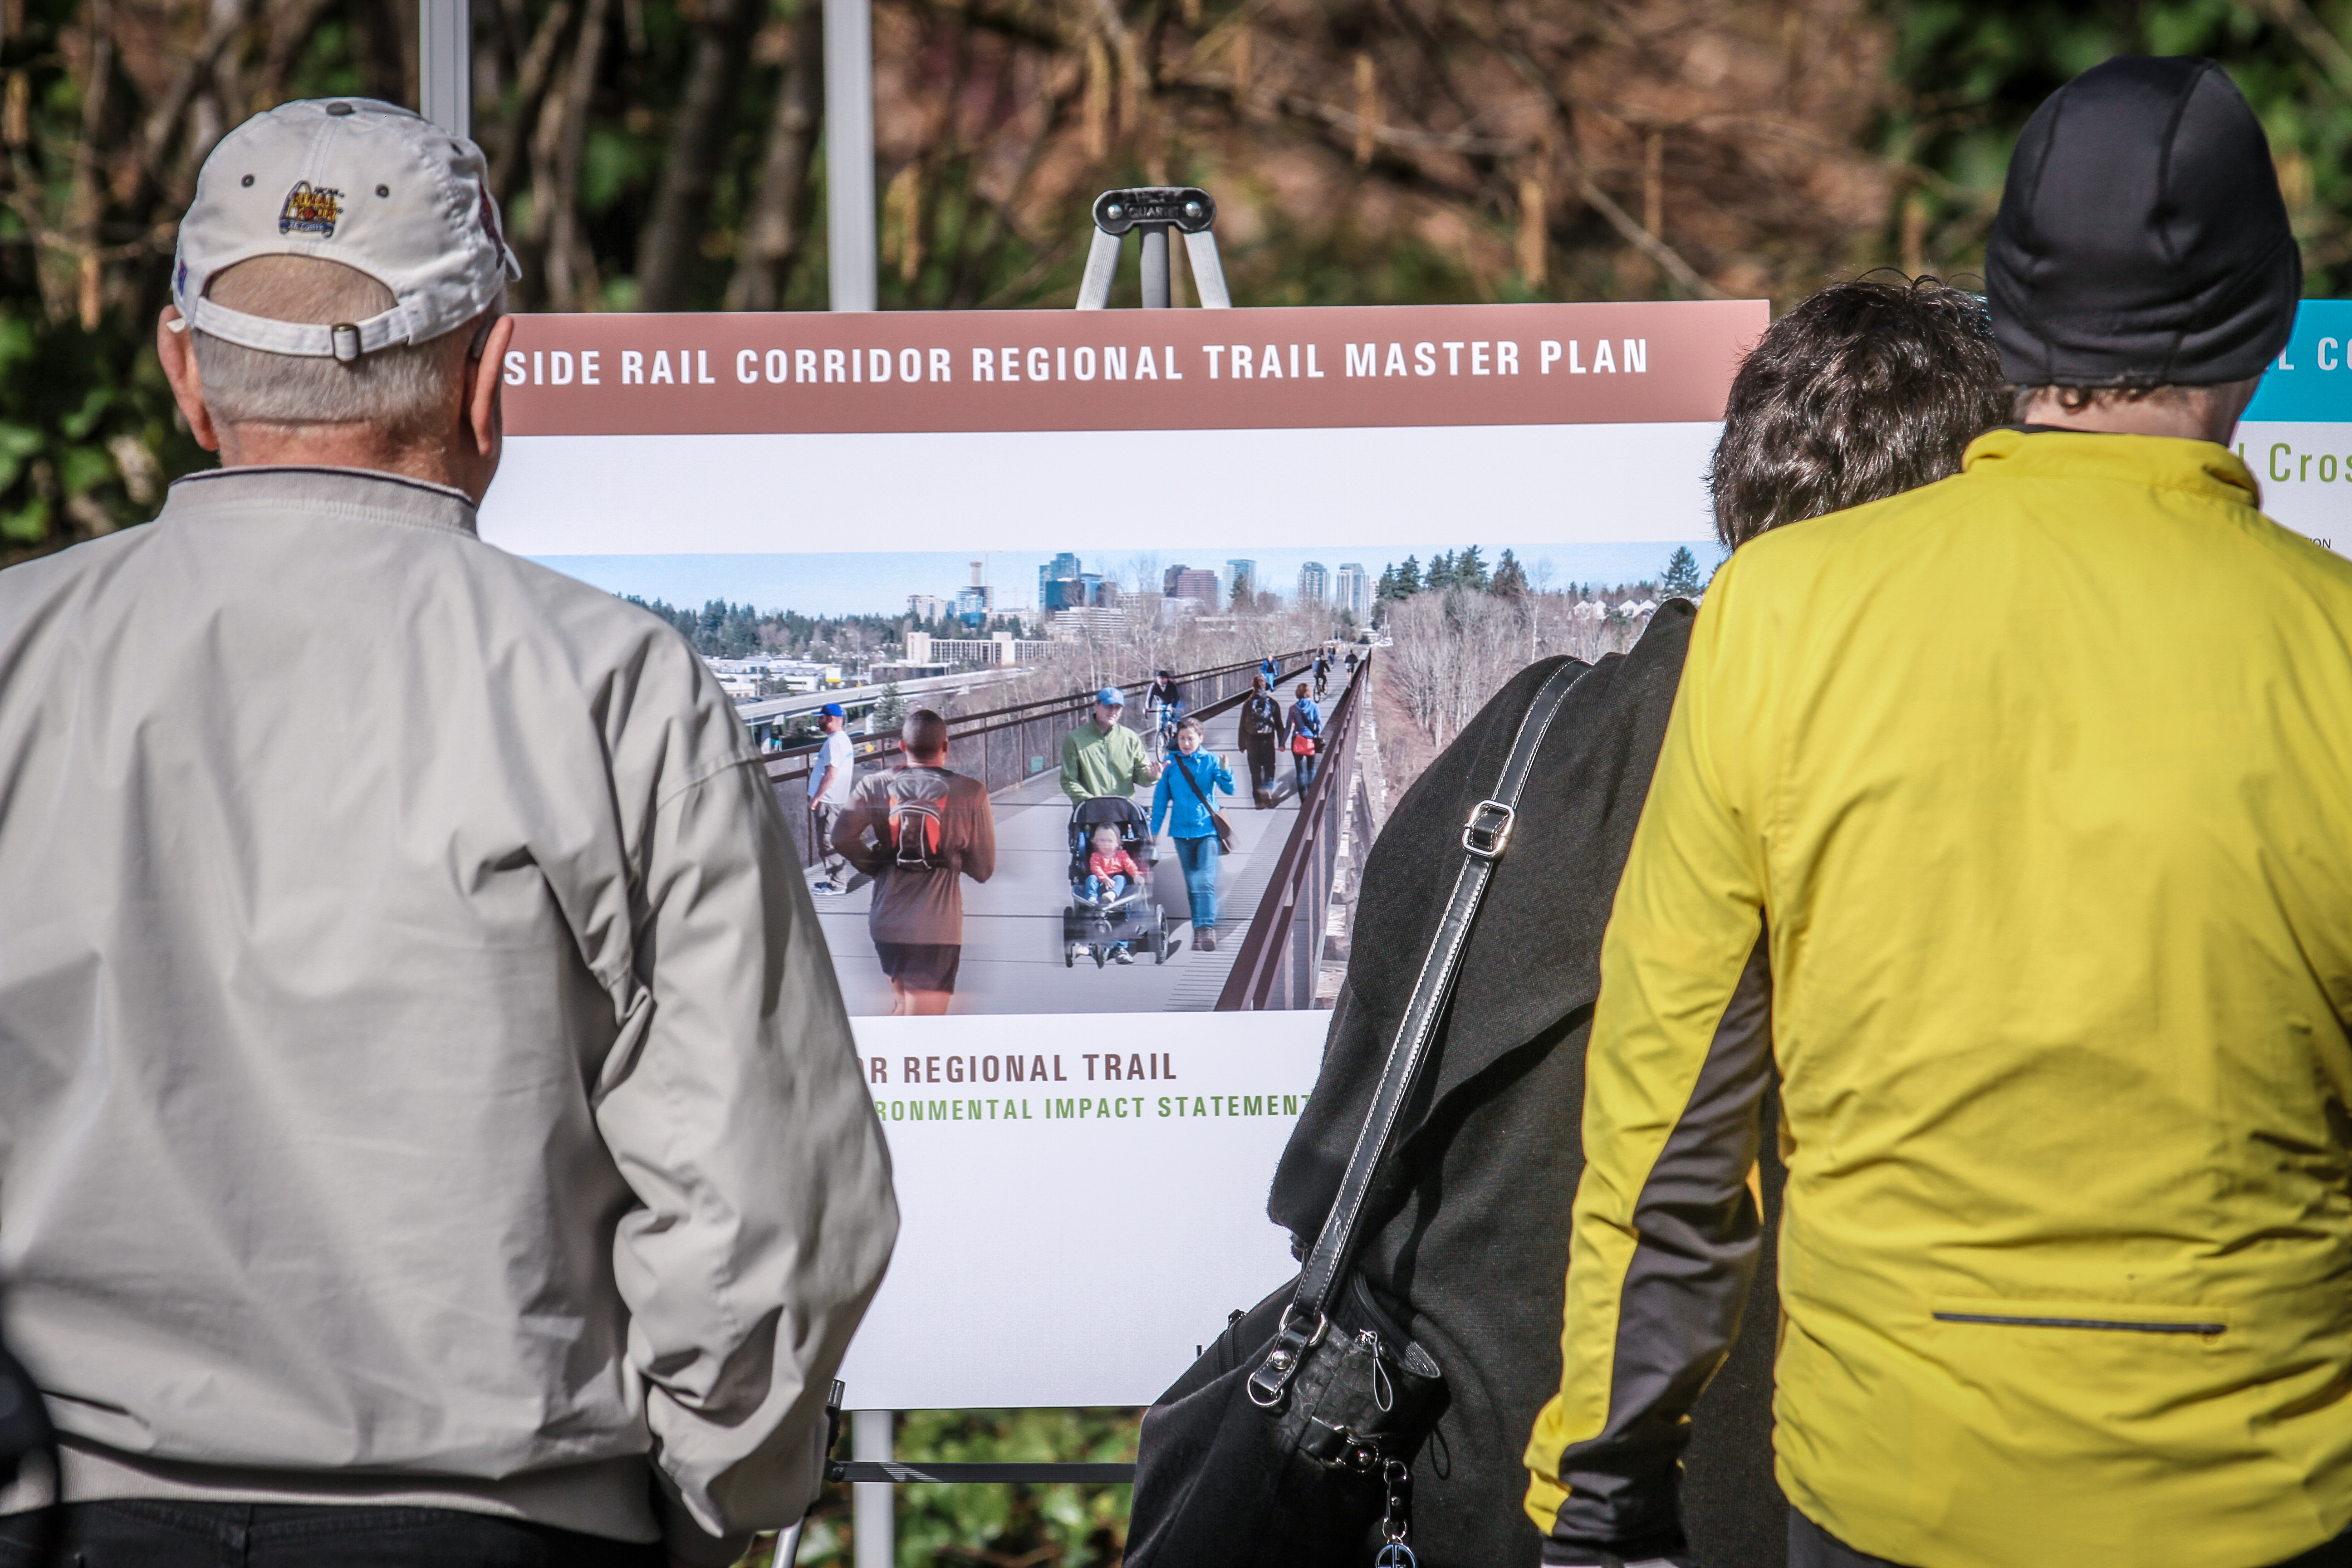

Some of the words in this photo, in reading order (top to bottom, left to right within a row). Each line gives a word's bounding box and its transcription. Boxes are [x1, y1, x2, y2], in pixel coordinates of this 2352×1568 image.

[504, 351, 600, 386] SIDE
[622, 350, 715, 384] RAIL
[736, 348, 951, 384] CORRIDOR
[972, 346, 1182, 382] REGIONAL
[1202, 344, 1324, 379] TRAIL
[1345, 341, 1519, 377] MASTER
[1540, 338, 1647, 374] PLAN
[2318, 337, 2352, 371] C
[858, 1057, 887, 1083] R
[904, 1054, 1067, 1083] REGIONAL
[1082, 1053, 1176, 1081] TRAIL
[874, 1099, 1032, 1121] RONMENTAL
[1047, 1097, 1145, 1118] IMPACT
